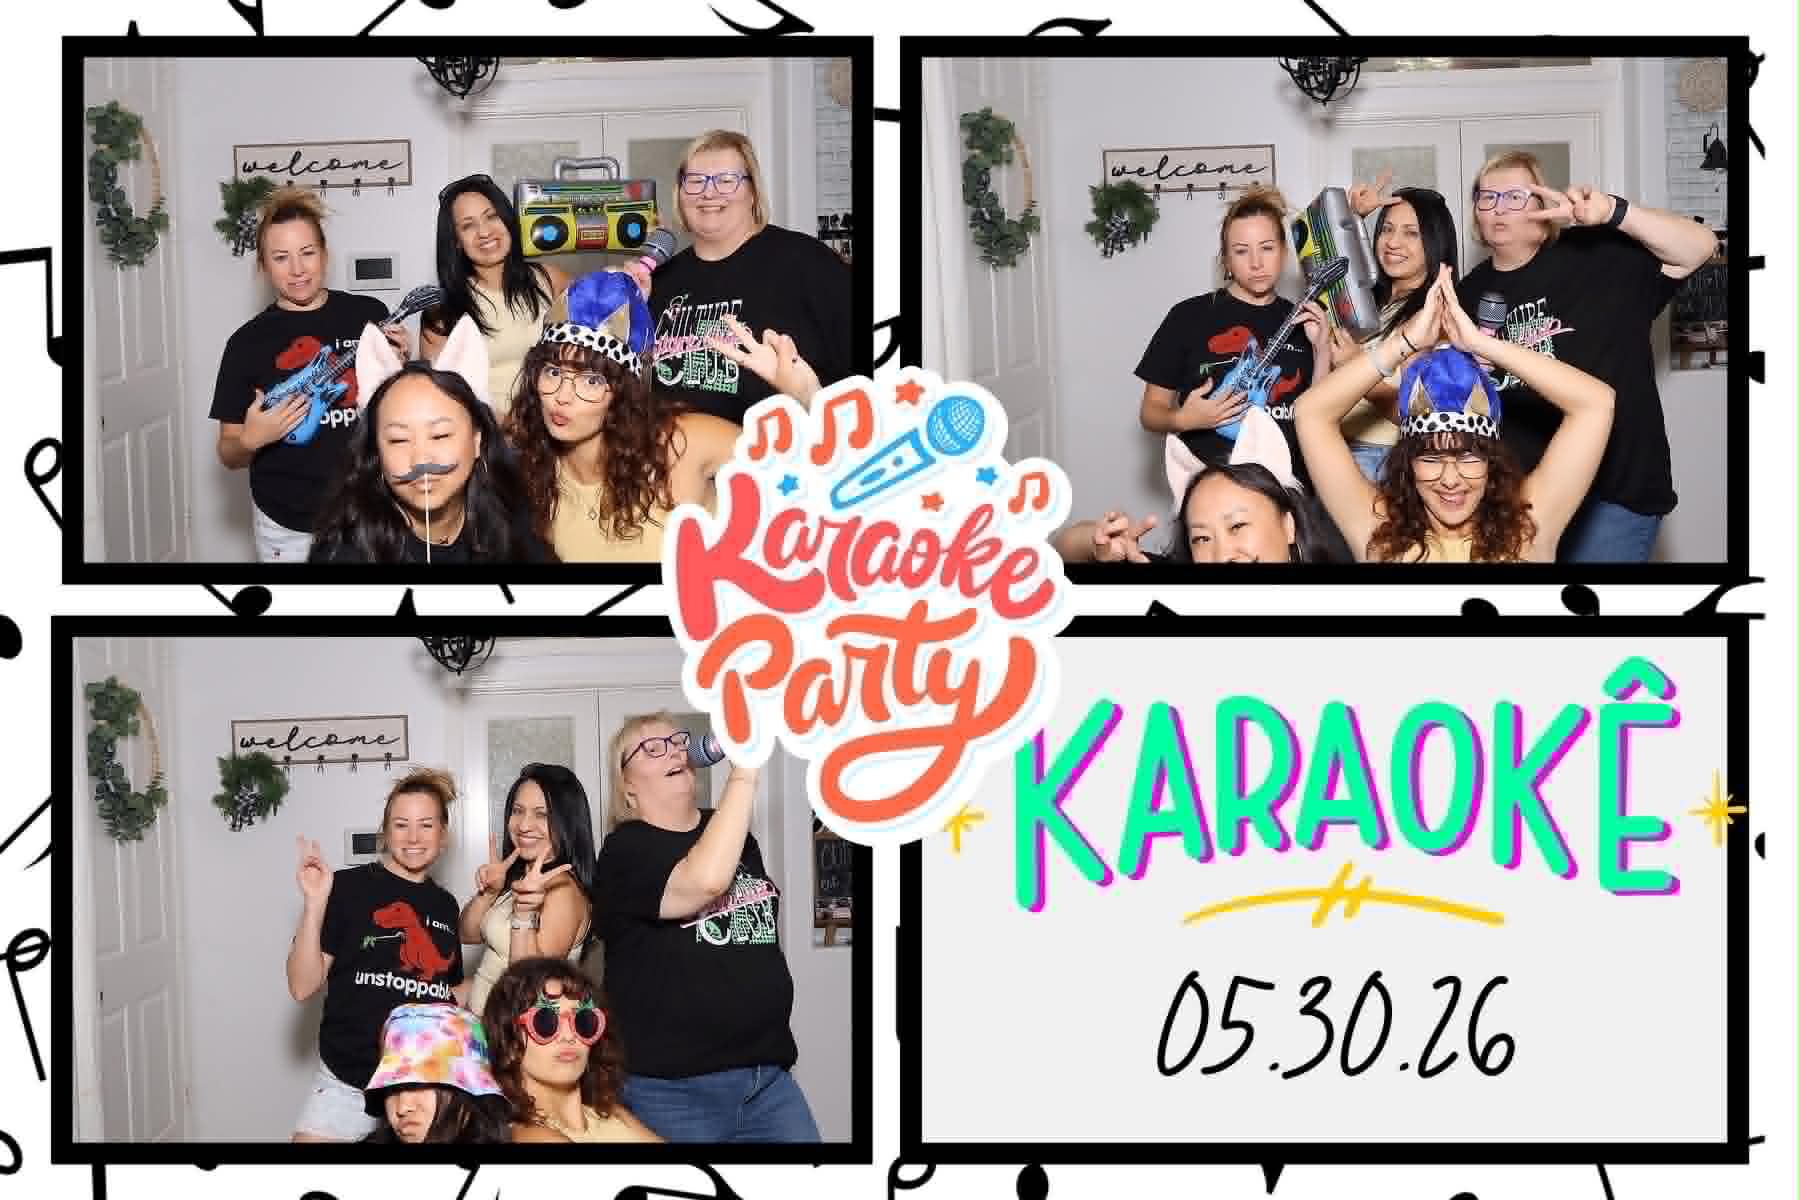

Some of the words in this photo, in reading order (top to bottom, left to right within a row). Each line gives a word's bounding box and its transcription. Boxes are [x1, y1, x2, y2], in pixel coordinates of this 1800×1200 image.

[241, 150, 404, 177] welcome
[1111, 154, 1269, 181] welcome
[240, 725, 401, 751] welcome
[355, 970, 451, 1001] unstoppabl
